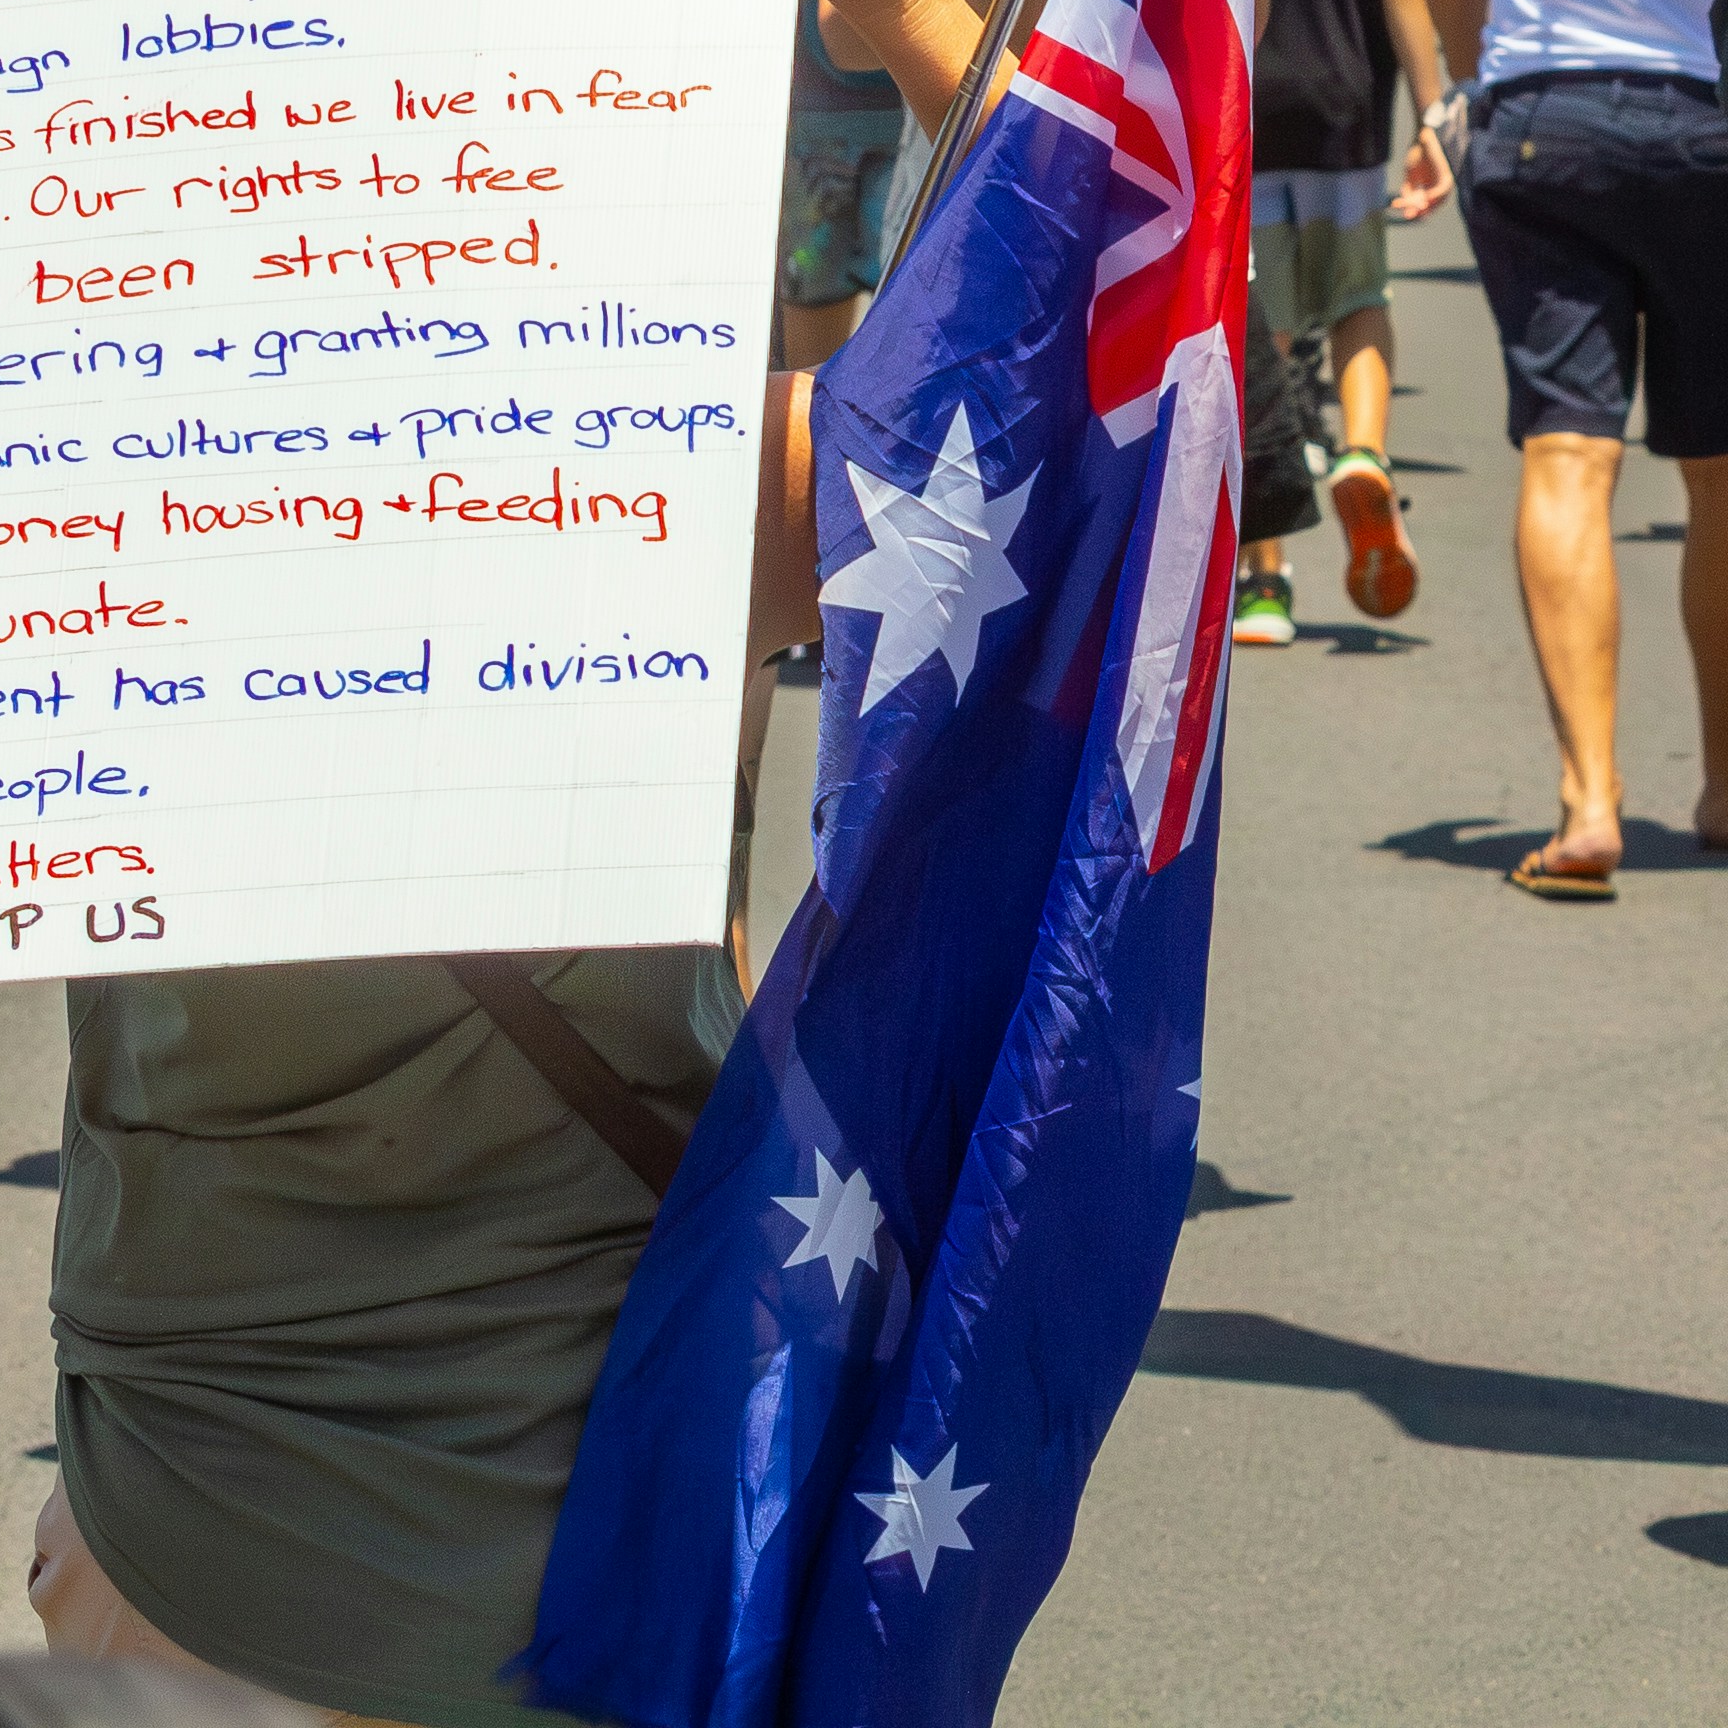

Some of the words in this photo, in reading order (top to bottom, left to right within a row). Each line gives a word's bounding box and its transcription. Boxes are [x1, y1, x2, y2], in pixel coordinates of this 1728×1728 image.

[35, 90, 257, 154] finished
[285, 100, 356, 127] we
[395, 80, 476, 121] live
[508, 72, 563, 114] in
[577, 70, 711, 112] fear
[31, 176, 144, 218] Our
[173, 160, 341, 213] rights
[360, 153, 420, 197] to
[442, 141, 563, 193] free
[33, 259, 194, 304] been
[251, 311, 489, 376] granting
[519, 301, 735, 348] millions
[113, 420, 328, 458] cultures
[400, 398, 552, 458] pride
[162, 486, 363, 540] housing
[421, 467, 667, 542] feeding
[114, 668, 205, 709] has
[245, 639, 430, 700] caused
[479, 634, 708, 691] division
[87, 896, 164, 942] US
